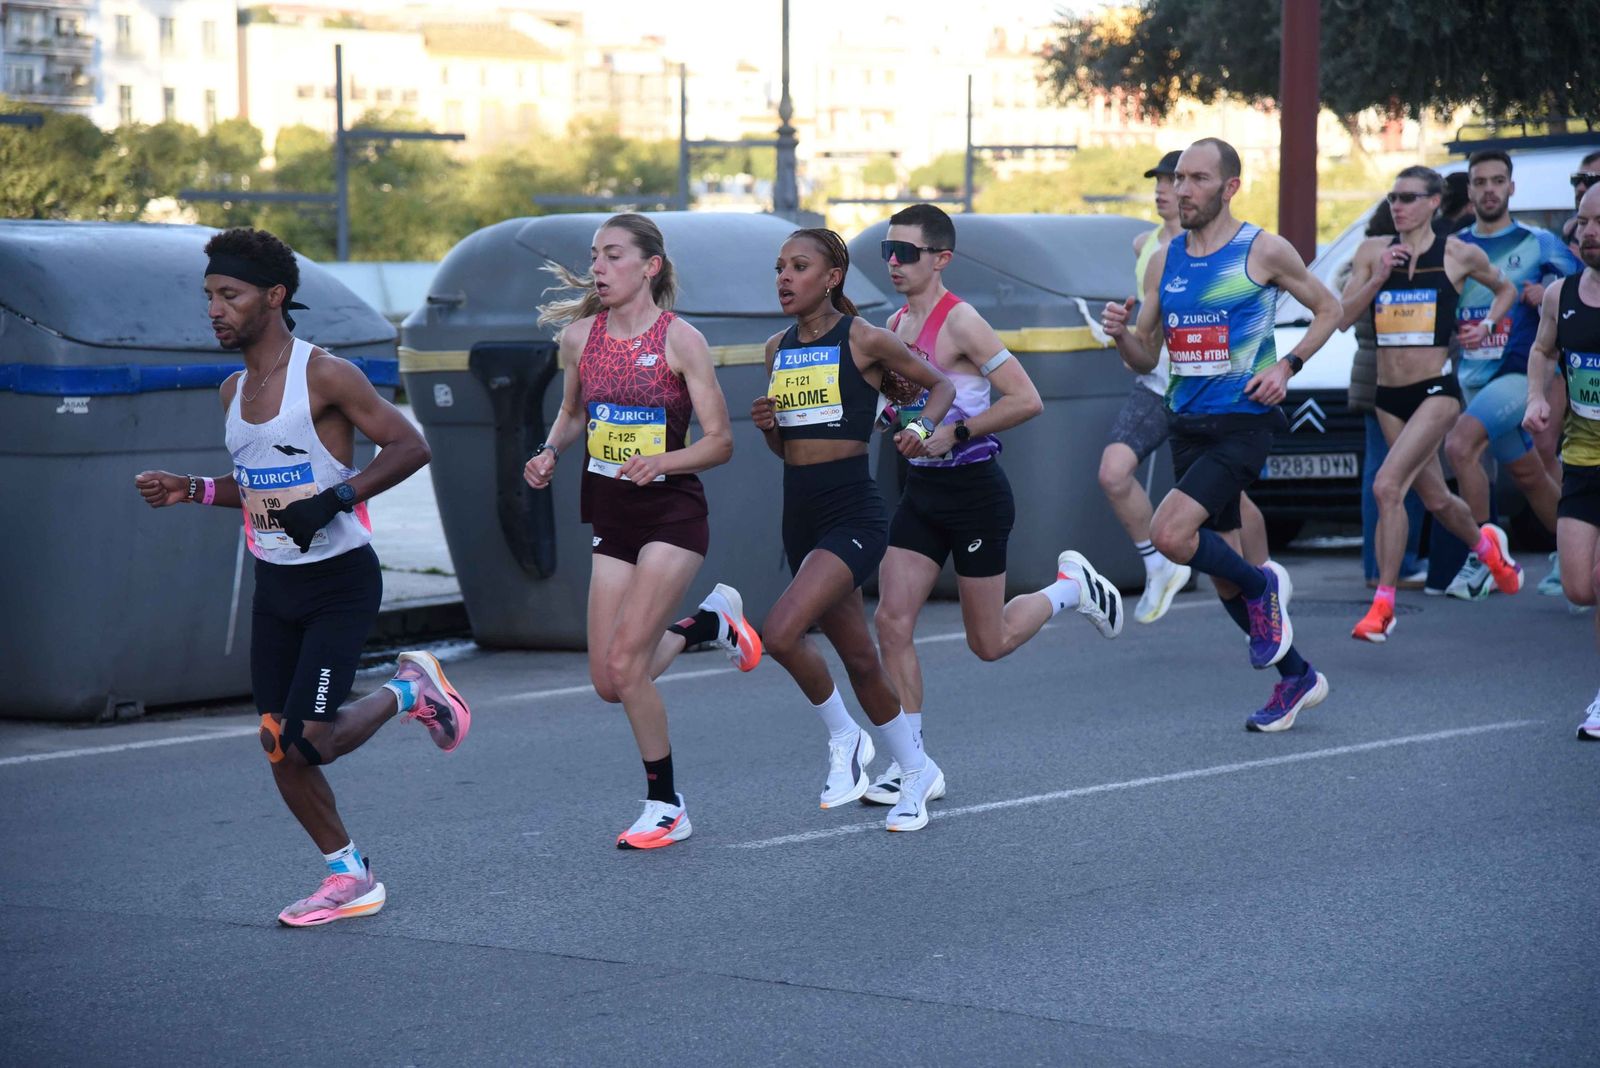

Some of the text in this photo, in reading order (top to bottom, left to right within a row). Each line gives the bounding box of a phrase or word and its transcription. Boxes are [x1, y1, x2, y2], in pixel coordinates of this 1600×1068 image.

[1395, 293, 1429, 302] ZURICH
[1183, 314, 1220, 324] ZURICH
[1187, 334, 1202, 343] 802
[785, 352, 829, 365] ZURICH
[1204, 349, 1229, 360] #TBH
[786, 376, 810, 387] F-121
[775, 388, 829, 409] SALOME
[1580, 389, 1600, 403] MA
[613, 410, 654, 421] ZURICH
[608, 431, 636, 442] F-125
[603, 445, 642, 461] ELISA
[1269, 456, 1314, 475] 9283
[252, 470, 301, 485] ZURICH
[262, 498, 281, 508] 190
[250, 512, 285, 530] AMA
[1270, 592, 1282, 643] KIPRUN
[314, 668, 331, 713] KIPRUN
